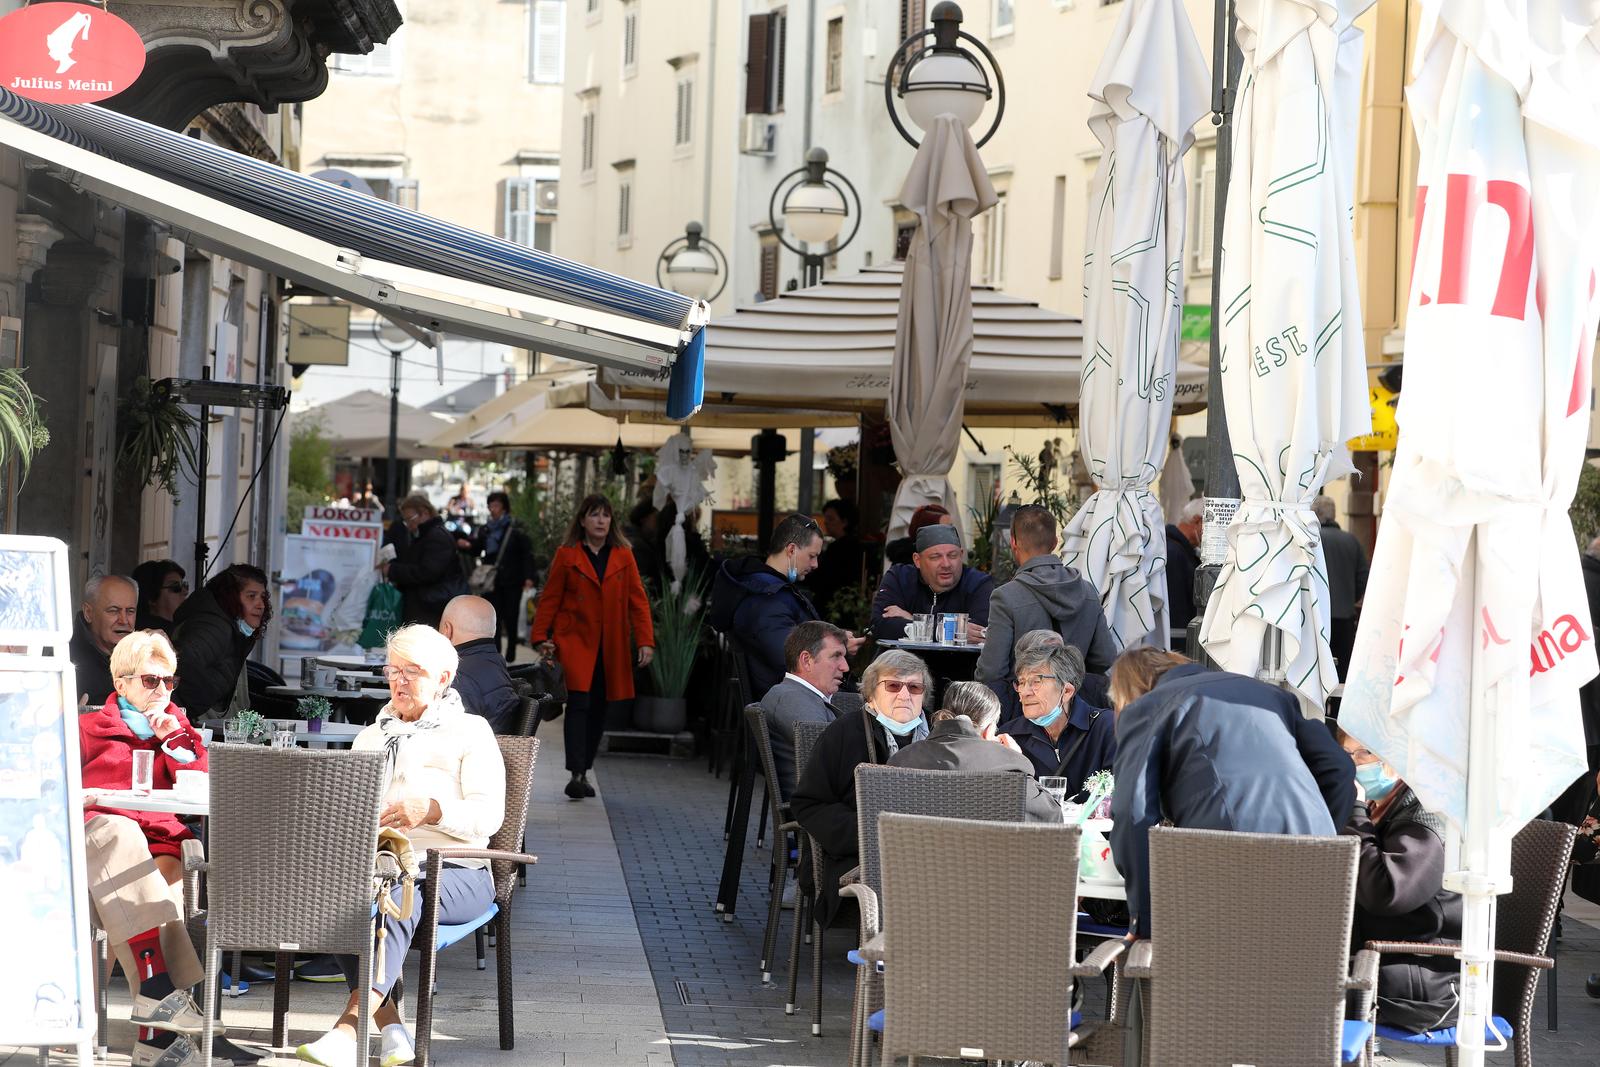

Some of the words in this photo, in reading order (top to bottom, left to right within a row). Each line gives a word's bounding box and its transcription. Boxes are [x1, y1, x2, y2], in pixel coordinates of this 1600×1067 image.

[10, 76, 62, 90] Julius
[67, 79, 113, 92] Meinl
[1253, 325, 1308, 378] EST.
[313, 507, 375, 522] LOKOT
[309, 525, 379, 540] NOVO!
